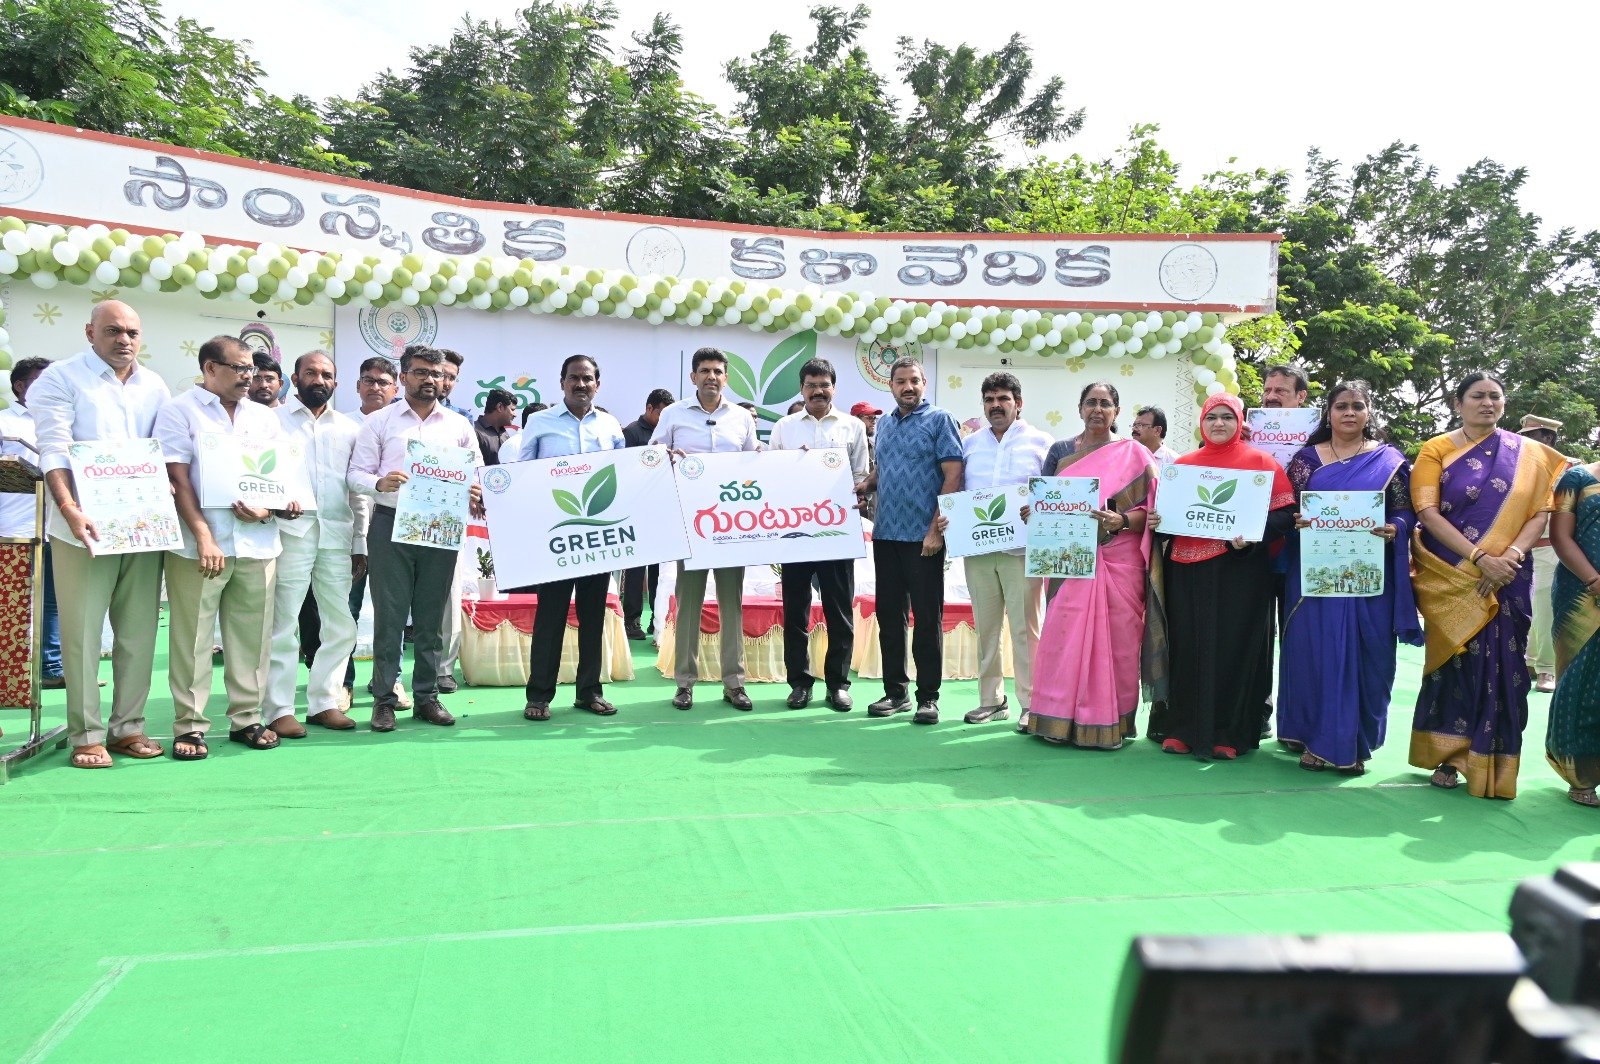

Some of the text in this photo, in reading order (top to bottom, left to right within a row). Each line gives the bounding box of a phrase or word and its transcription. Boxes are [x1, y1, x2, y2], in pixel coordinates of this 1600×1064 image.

[1252, 430, 1307, 443] గుంటూర
[411, 462, 466, 481] గుంటూరు
[239, 482, 284, 494] GREEN
[719, 480, 762, 502] నవ
[693, 499, 847, 539] గుంటూరు
[1185, 511, 1235, 524] GREEN
[1310, 516, 1376, 530] గుంటూరు
[972, 526, 1015, 540] GREEN
[1187, 522, 1232, 531] GUNTUR
[549, 525, 636, 554] GREEN
[975, 536, 1014, 547] GUNTUR
[557, 546, 635, 567] GUNTUR
